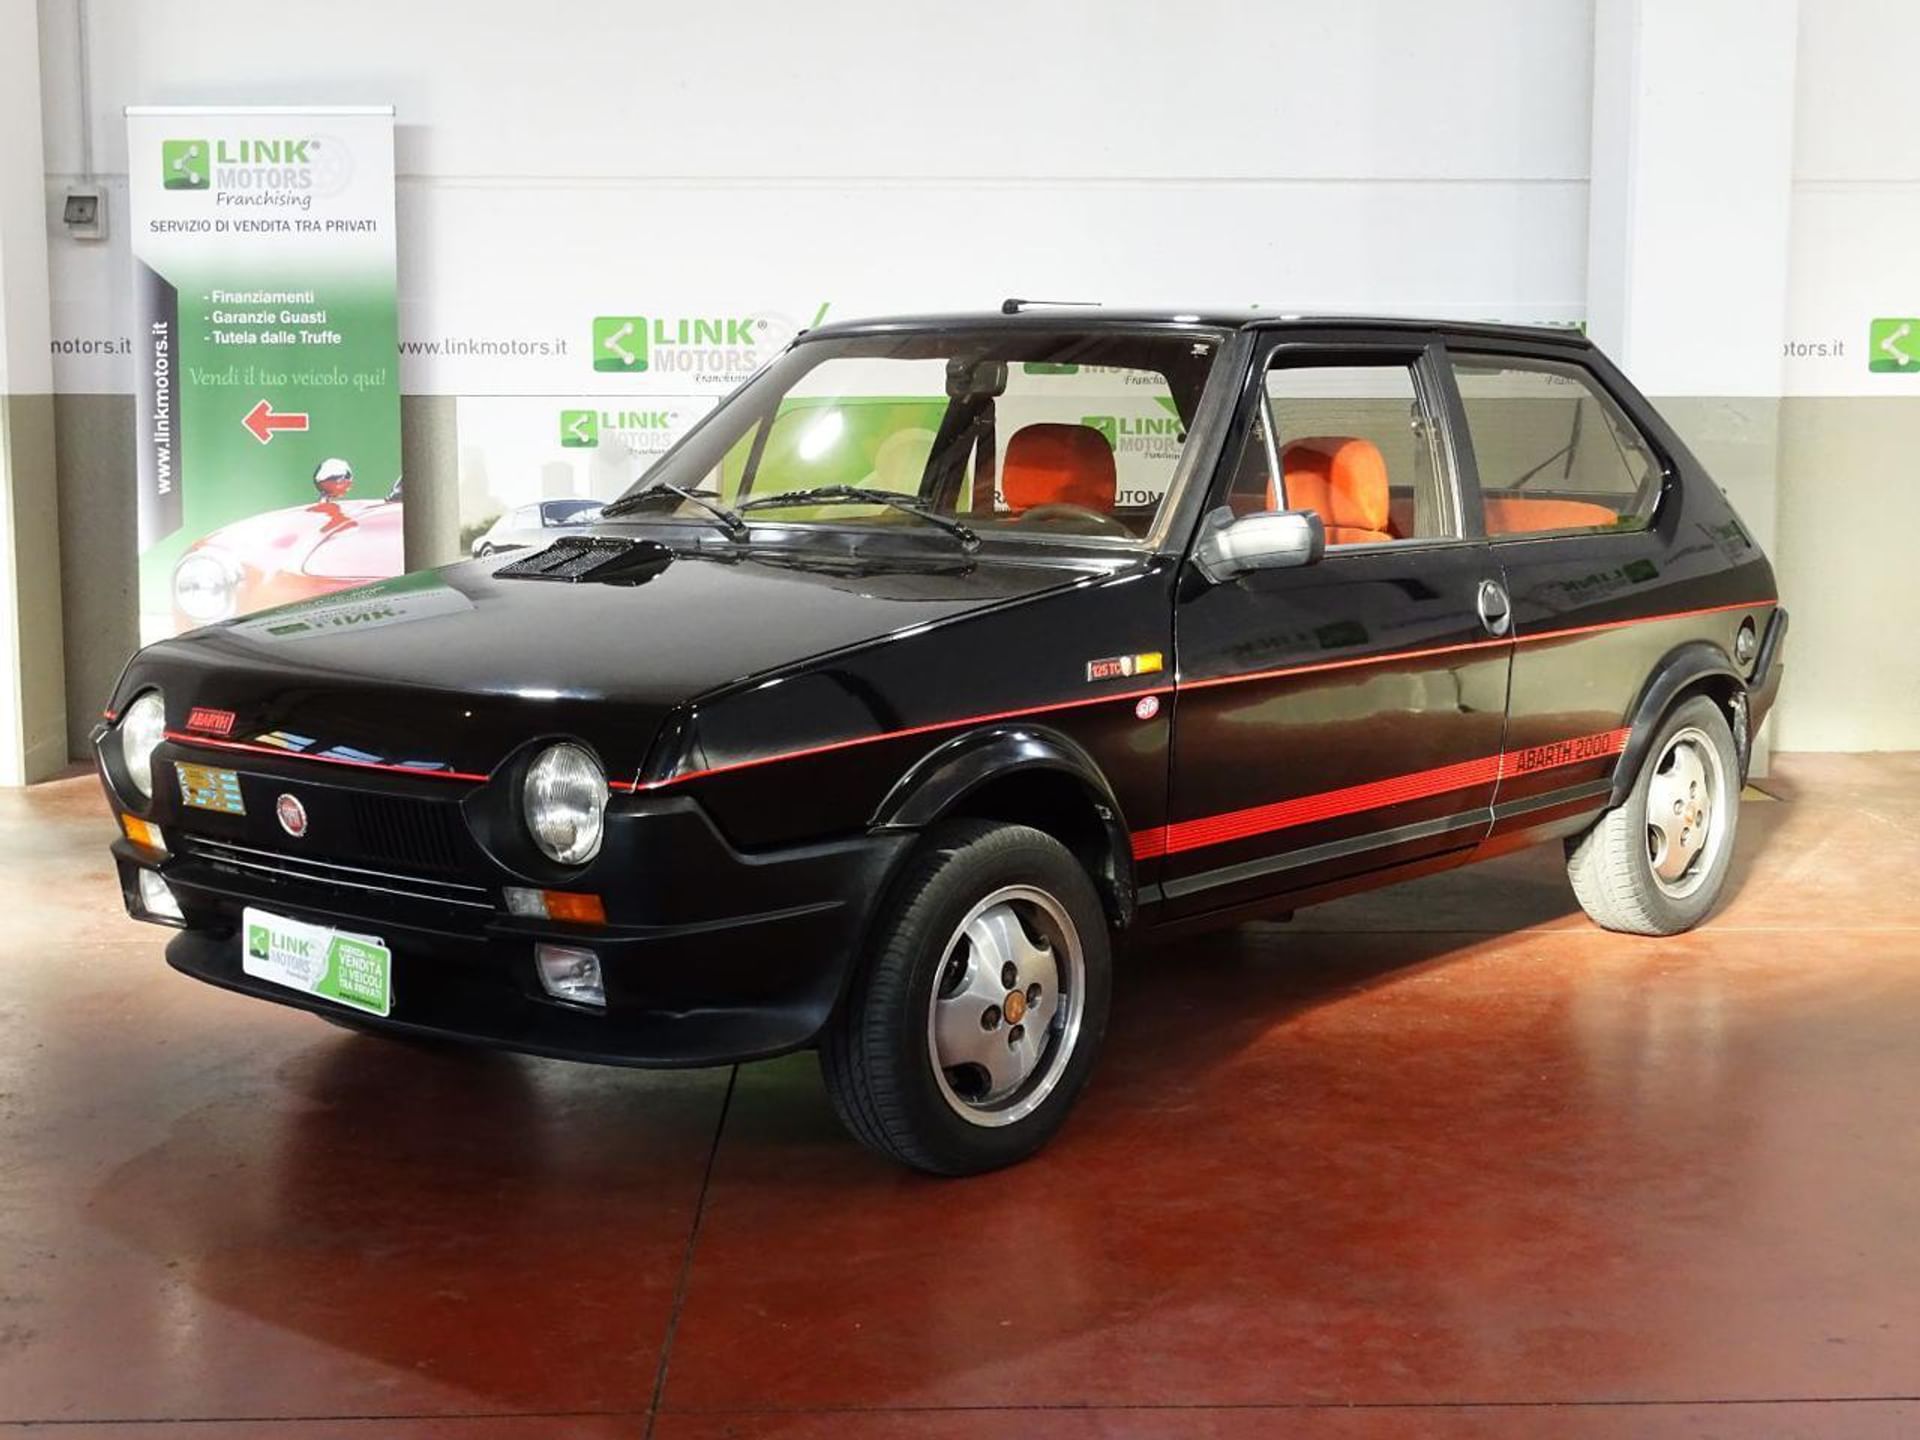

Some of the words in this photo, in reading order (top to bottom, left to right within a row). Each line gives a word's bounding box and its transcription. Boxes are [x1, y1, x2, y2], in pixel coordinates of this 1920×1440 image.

[216, 168, 312, 189] MOTORS
[216, 190, 312, 210] Franchising
[150, 220, 211, 232] SERVIZIO
[216, 220, 229, 232] DI
[235, 220, 291, 232] VENDITA
[295, 220, 321, 232] TRA
[326, 220, 377, 232] PRIVATI
[212, 290, 315, 304] Finanziamenti
[212, 311, 276, 324] Garanzie
[280, 310, 326, 324] Guasti
[213, 331, 257, 344] Tutela
[261, 331, 296, 344] dalle
[300, 331, 341, 344] Truffe
[654, 350, 758, 372] MOTORS
[190, 366, 239, 386] Vendi
[243, 366, 255, 386] il
[259, 368, 288, 386] tuo
[292, 366, 349, 386] veicolo
[353, 368, 386, 393] qui!
[152, 321, 171, 495] www.linkmotors.it
[1516, 743, 1571, 772] ABARTH
[1575, 733, 1609, 760] 2000
